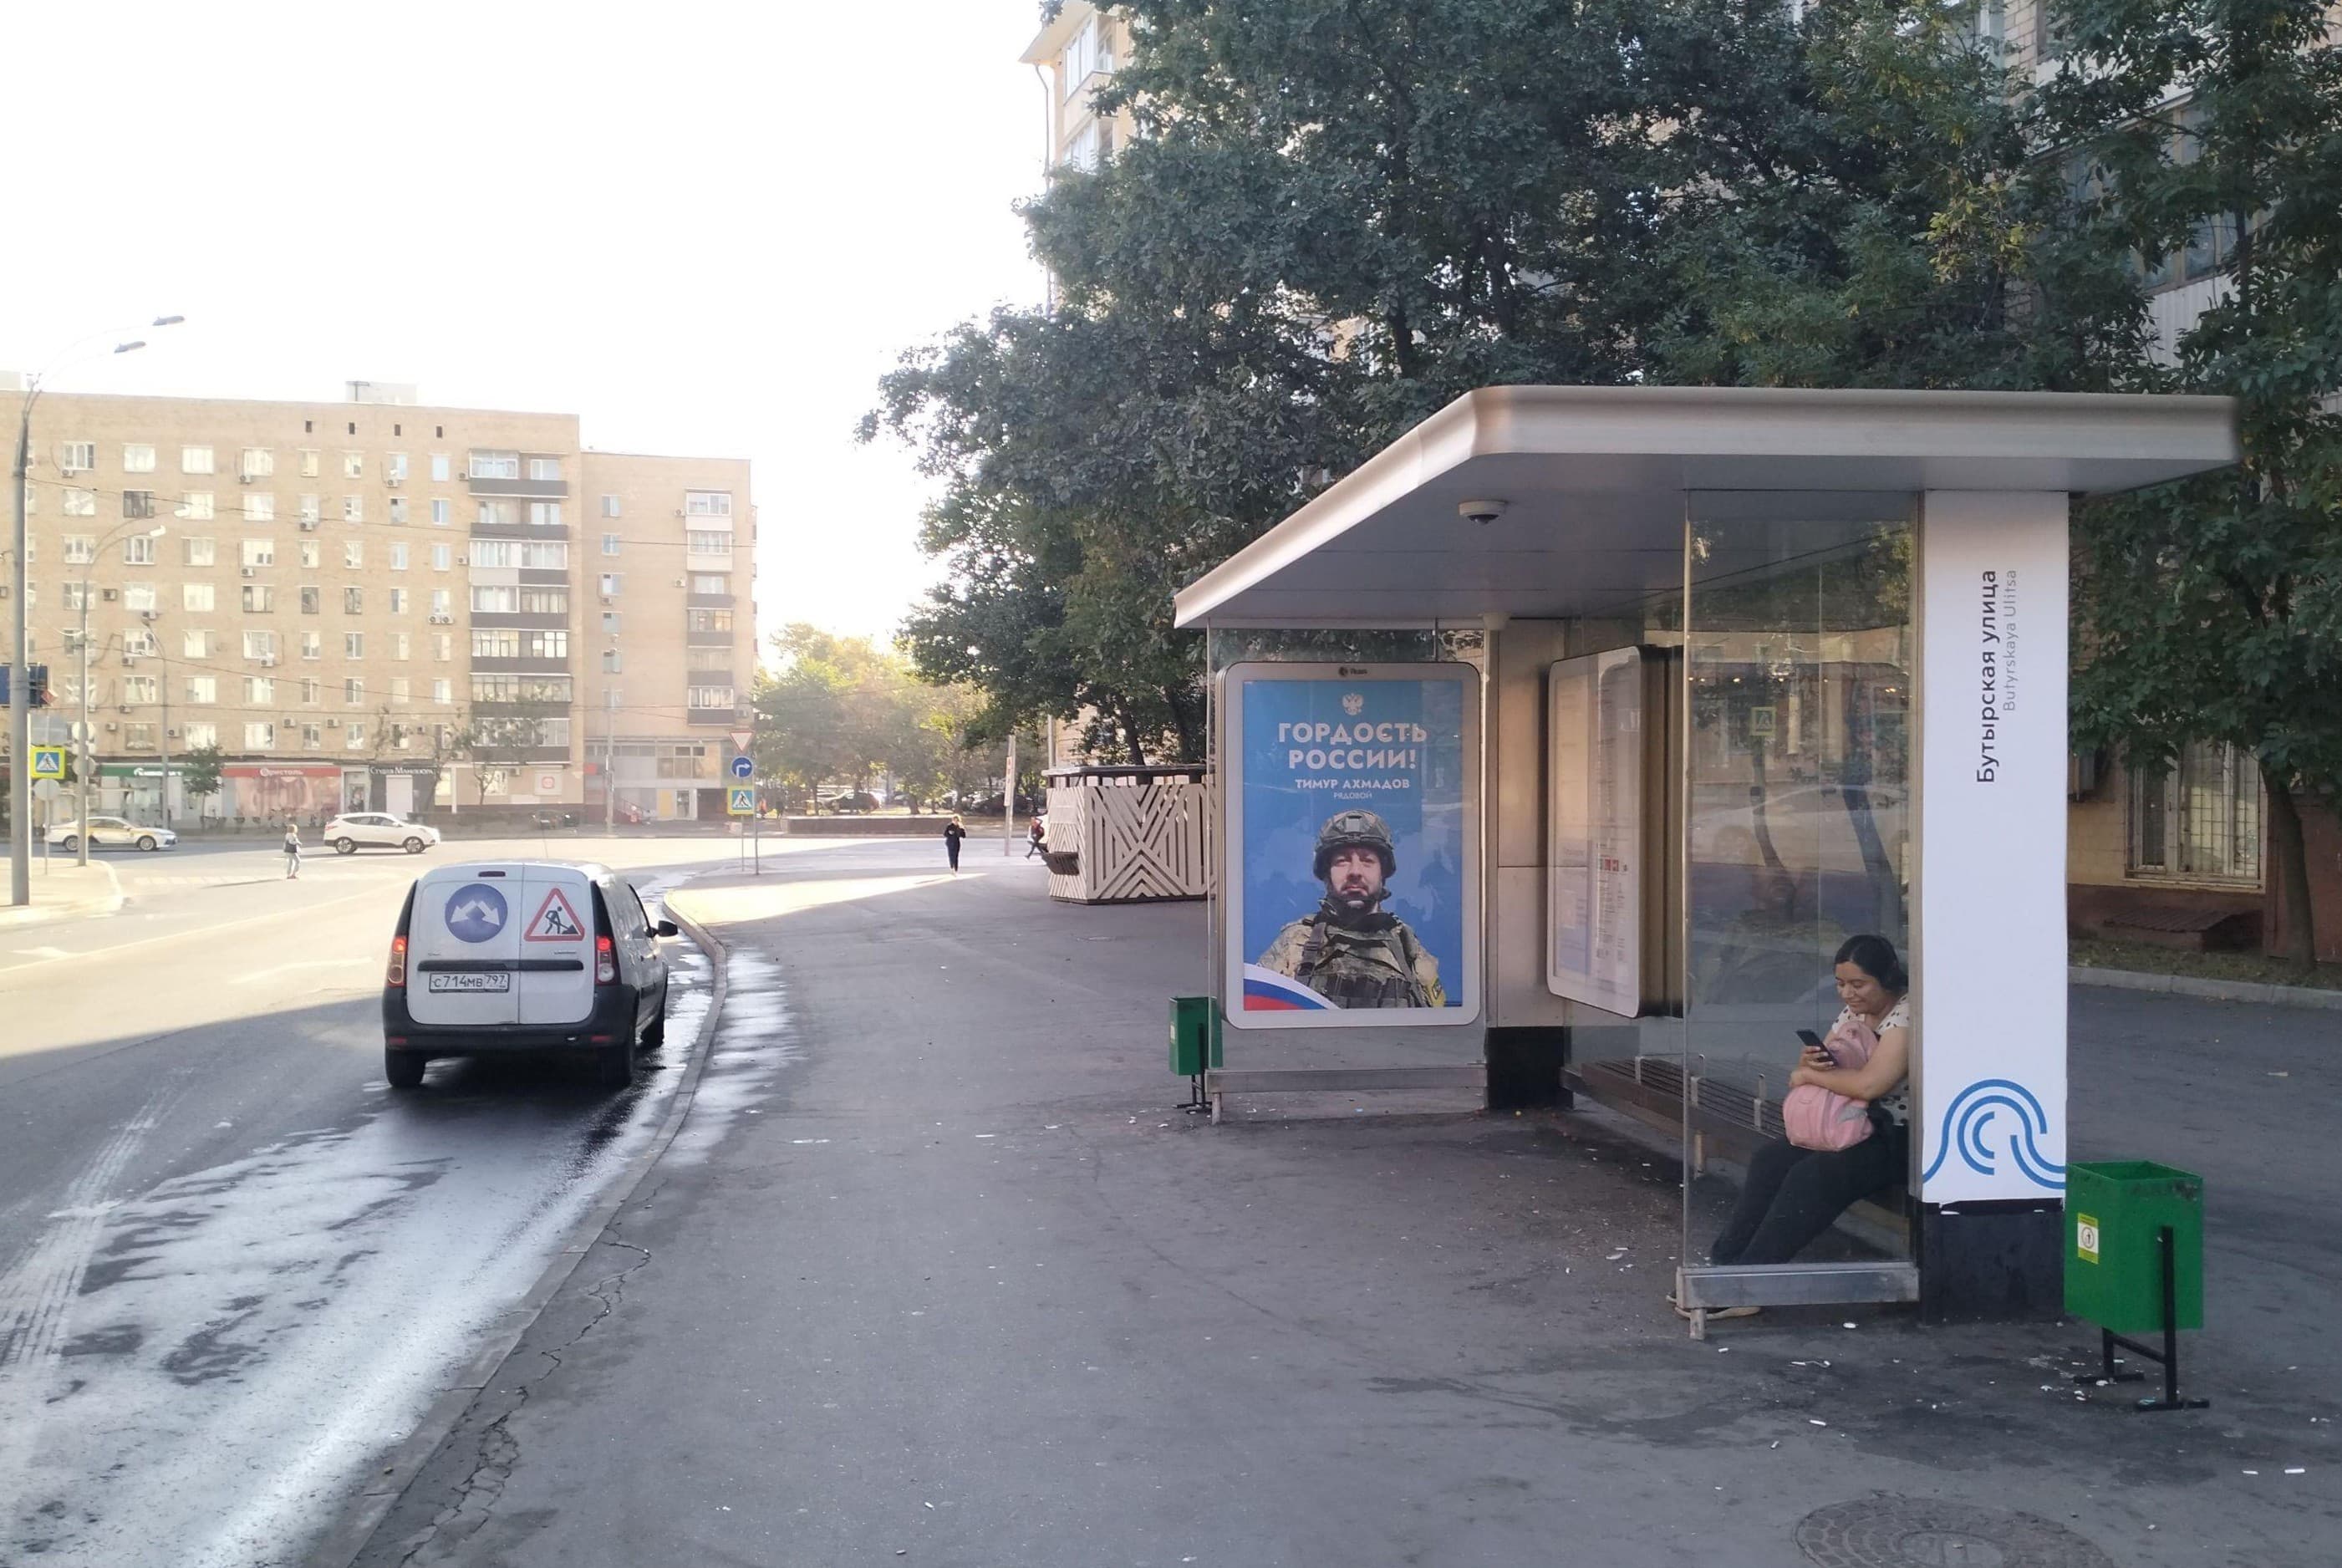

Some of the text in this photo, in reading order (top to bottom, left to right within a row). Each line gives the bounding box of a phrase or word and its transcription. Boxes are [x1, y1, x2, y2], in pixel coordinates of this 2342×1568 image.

[2003, 569, 2019, 710] Butyrskaya Ulitsa
[1977, 570, 1999, 783] Бутырская улица
[1278, 722, 1428, 746] ГОРДОСТЬ
[1289, 749, 1417, 770] РОССИИ!
[1295, 779, 1410, 789] ТИМУР АХМАДОВ
[1333, 791, 1372, 800] РЯДОВОЙ
[486, 975, 505, 985] 797
